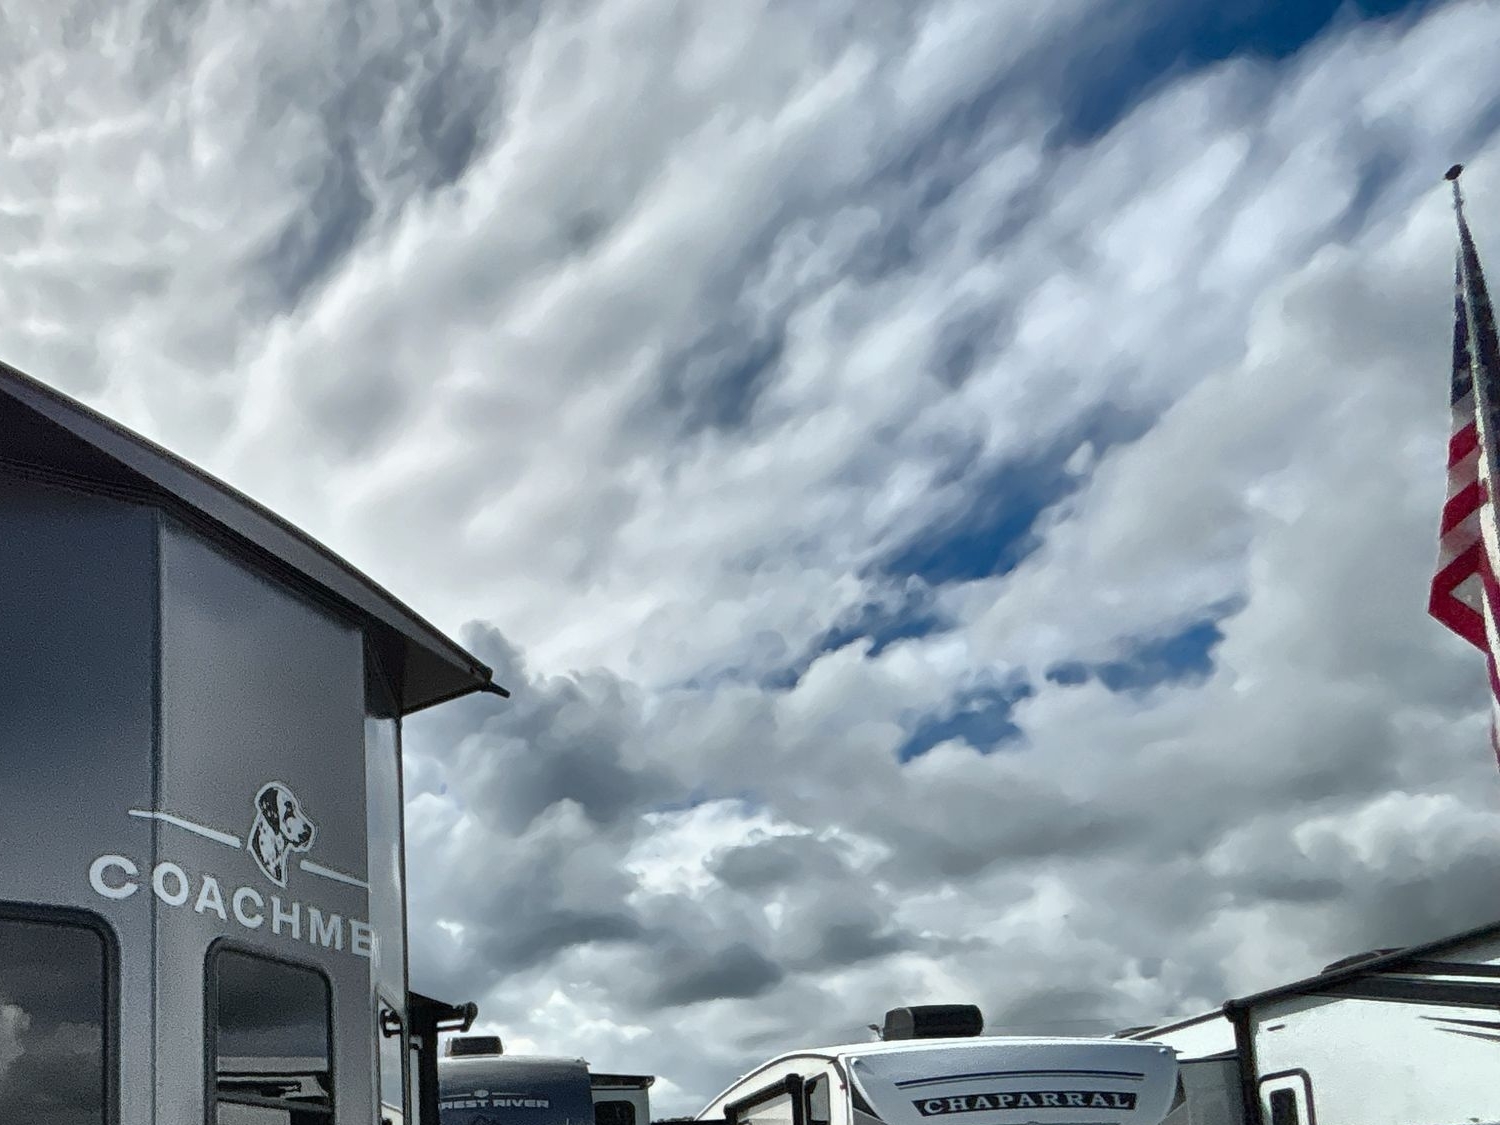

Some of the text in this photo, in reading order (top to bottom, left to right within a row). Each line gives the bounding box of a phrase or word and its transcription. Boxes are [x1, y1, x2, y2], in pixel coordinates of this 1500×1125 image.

[89, 854, 377, 960] COACHME
[438, 1099, 549, 1110] REST RIVER
[923, 1092, 1130, 1115] CHAPARRAL
